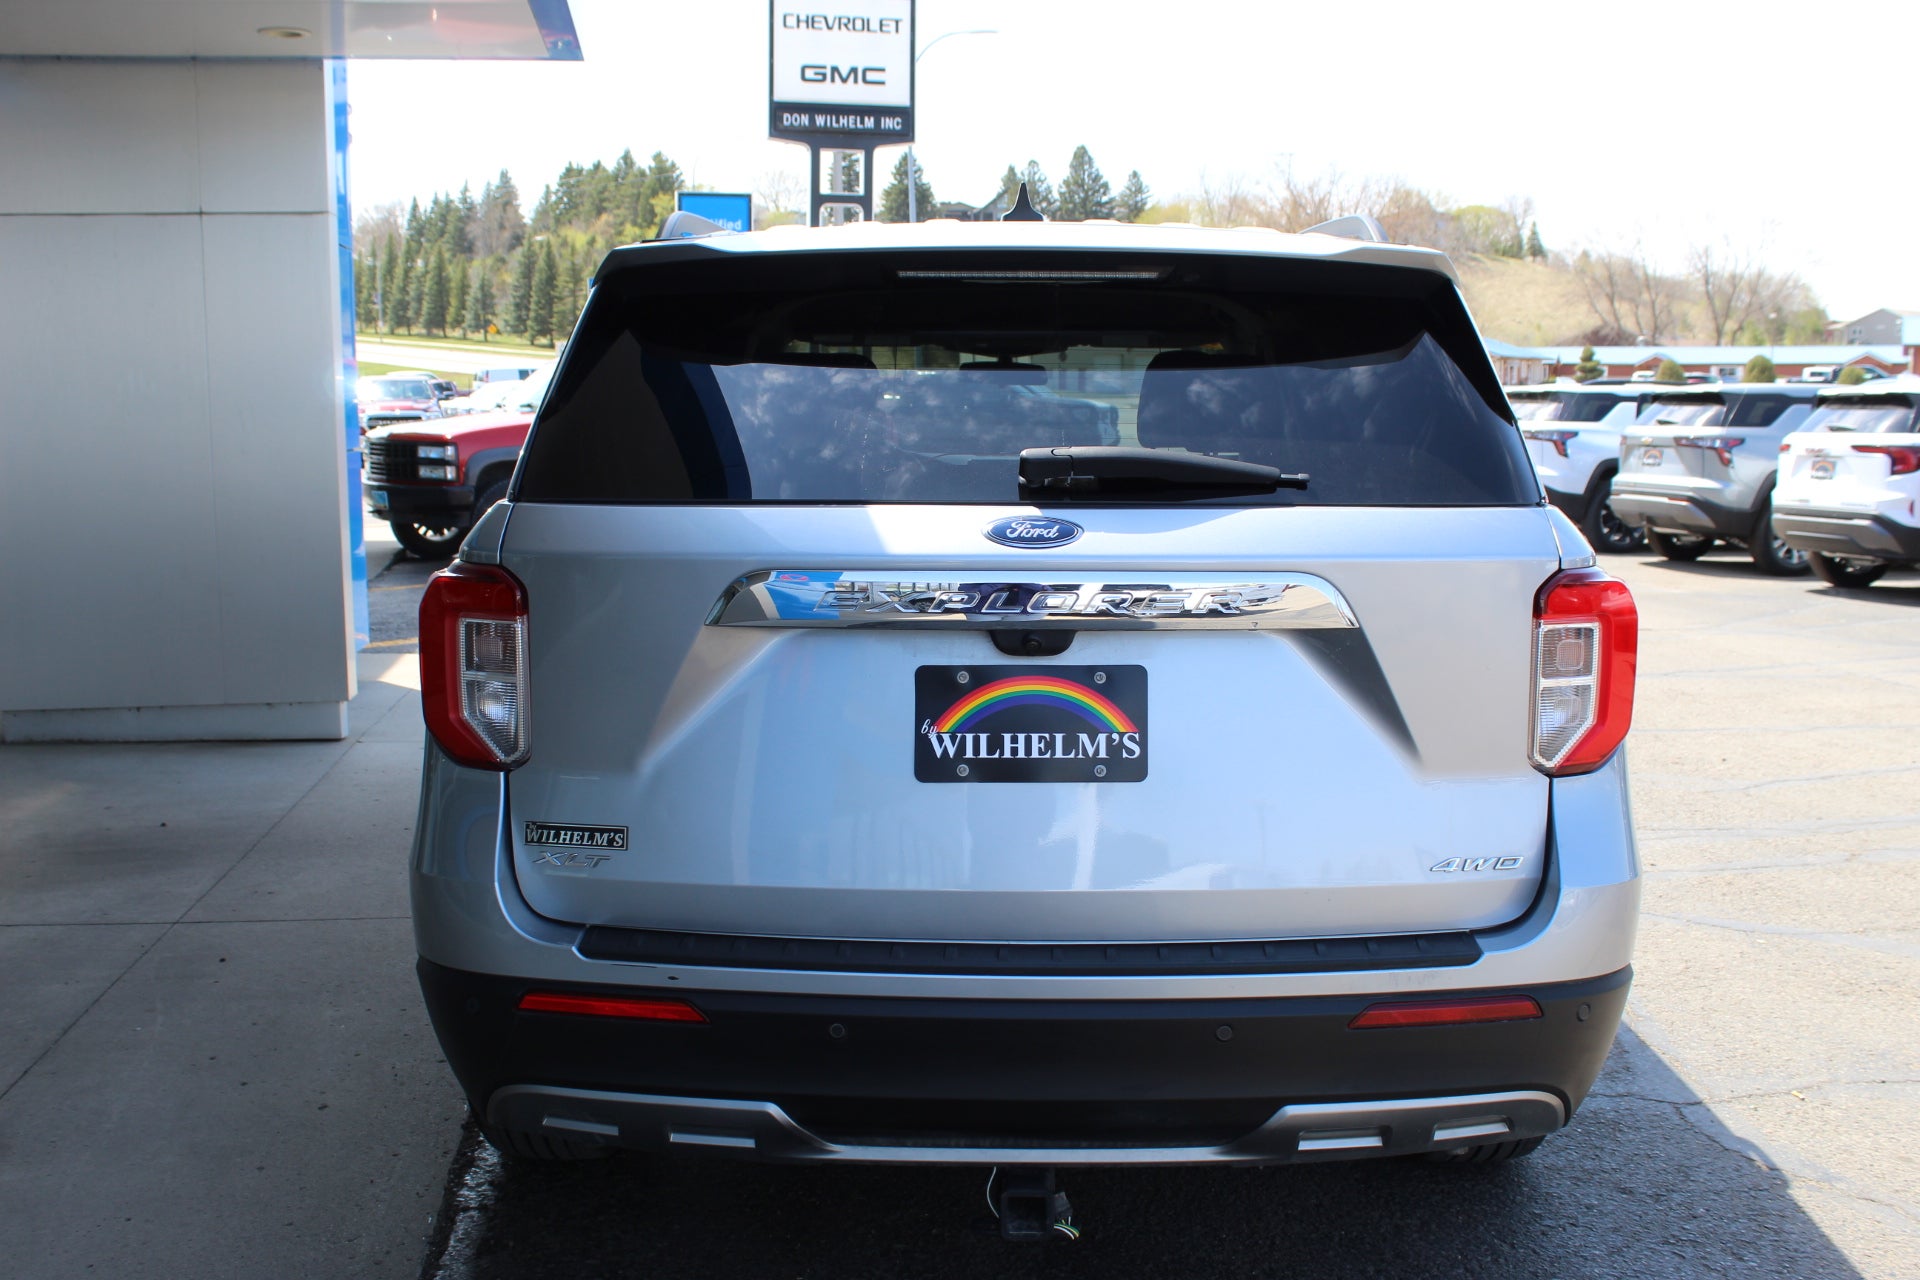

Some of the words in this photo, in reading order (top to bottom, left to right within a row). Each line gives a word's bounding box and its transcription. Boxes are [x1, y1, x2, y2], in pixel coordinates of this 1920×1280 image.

[783, 13, 902, 34] CHEVROLET
[801, 65, 886, 85] GMC
[782, 113, 809, 127] DON
[815, 114, 875, 129] WILHELM
[880, 117, 902, 130] INC
[1006, 520, 1060, 538] Ford
[813, 590, 1242, 614] EXPLORER
[921, 719, 938, 738] by
[928, 731, 1141, 759] WILHELM'S
[526, 828, 625, 847] WILHELM'S
[532, 851, 611, 868] XLT
[1430, 856, 1524, 873] 4WD
